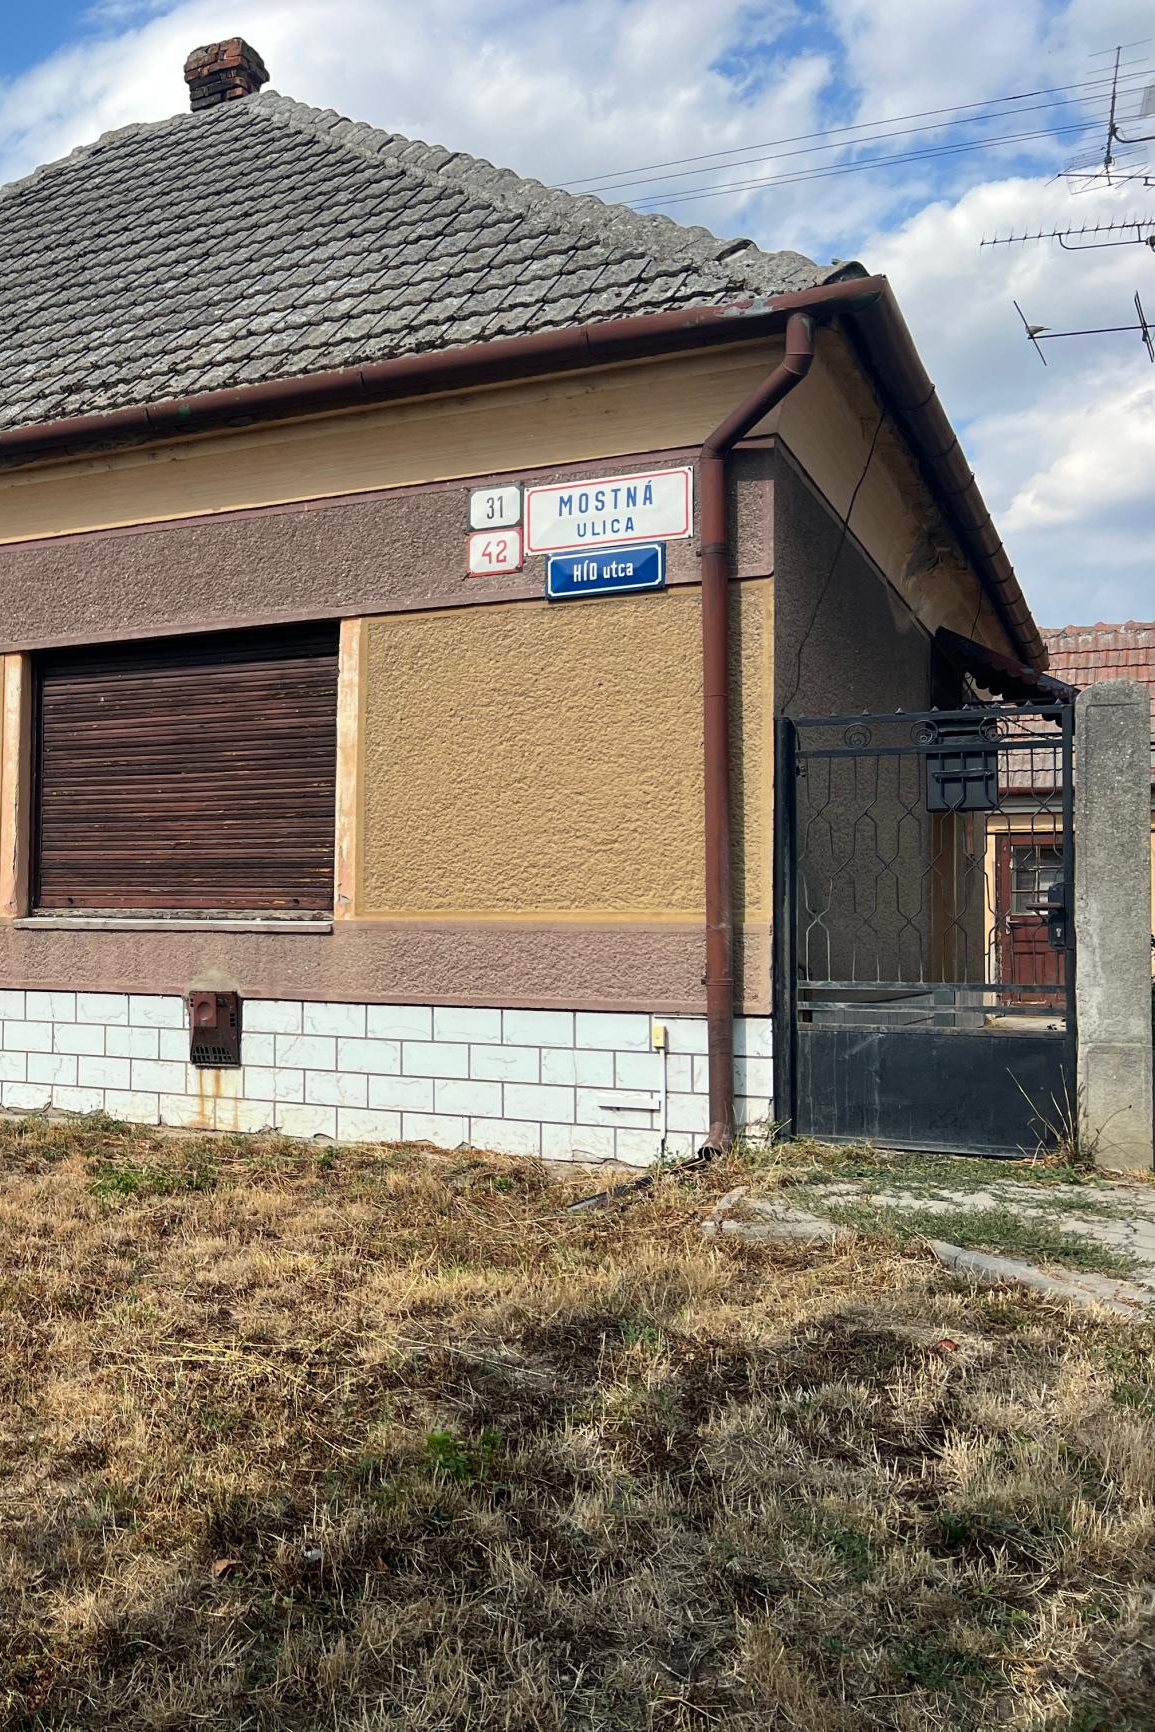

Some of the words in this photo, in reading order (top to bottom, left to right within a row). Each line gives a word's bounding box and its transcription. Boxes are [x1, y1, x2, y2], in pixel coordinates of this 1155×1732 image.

[486, 495, 504, 519] 31
[558, 480, 654, 516] MOSTNÁ
[576, 516, 635, 537] ULICA
[481, 539, 507, 564] 42
[573, 559, 598, 582] HÍD
[603, 562, 634, 579] utca
